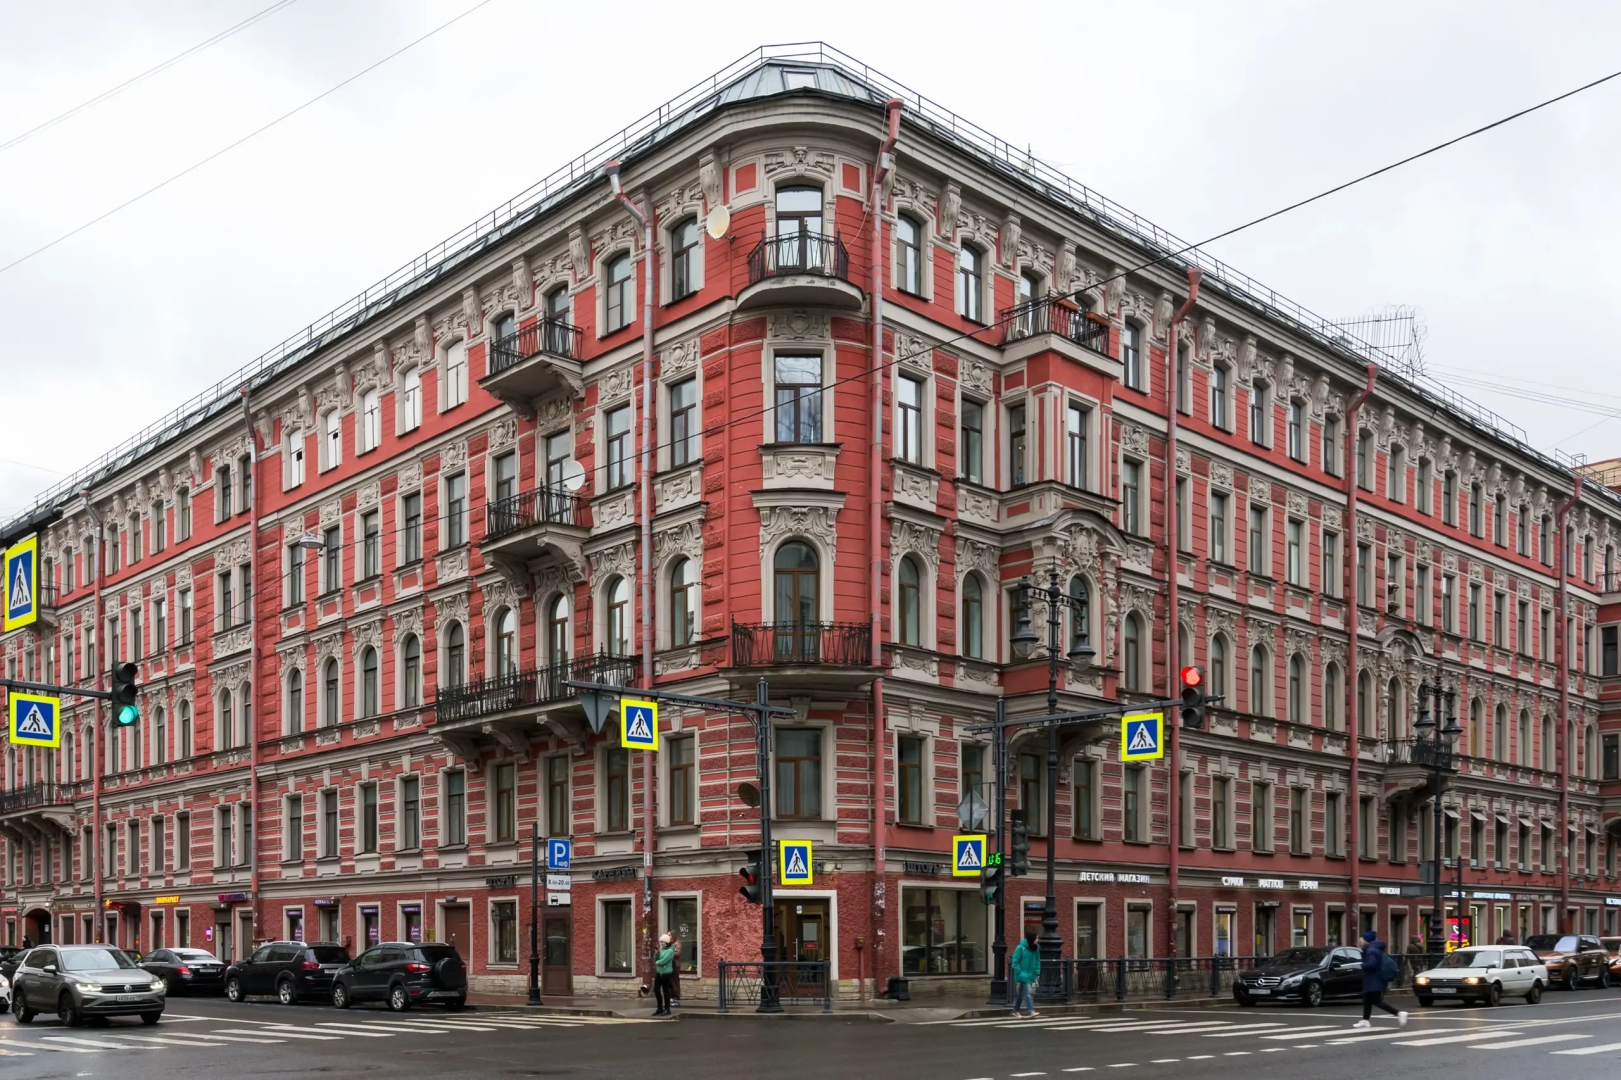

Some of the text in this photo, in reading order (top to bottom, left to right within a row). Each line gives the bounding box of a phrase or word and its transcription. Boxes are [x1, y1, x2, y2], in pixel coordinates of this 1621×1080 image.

[554, 842, 567, 866] P
[906, 861, 941, 874] ШТОРЫ
[1079, 871, 1150, 883] ДЕТСКИЙ МАГАЗИН
